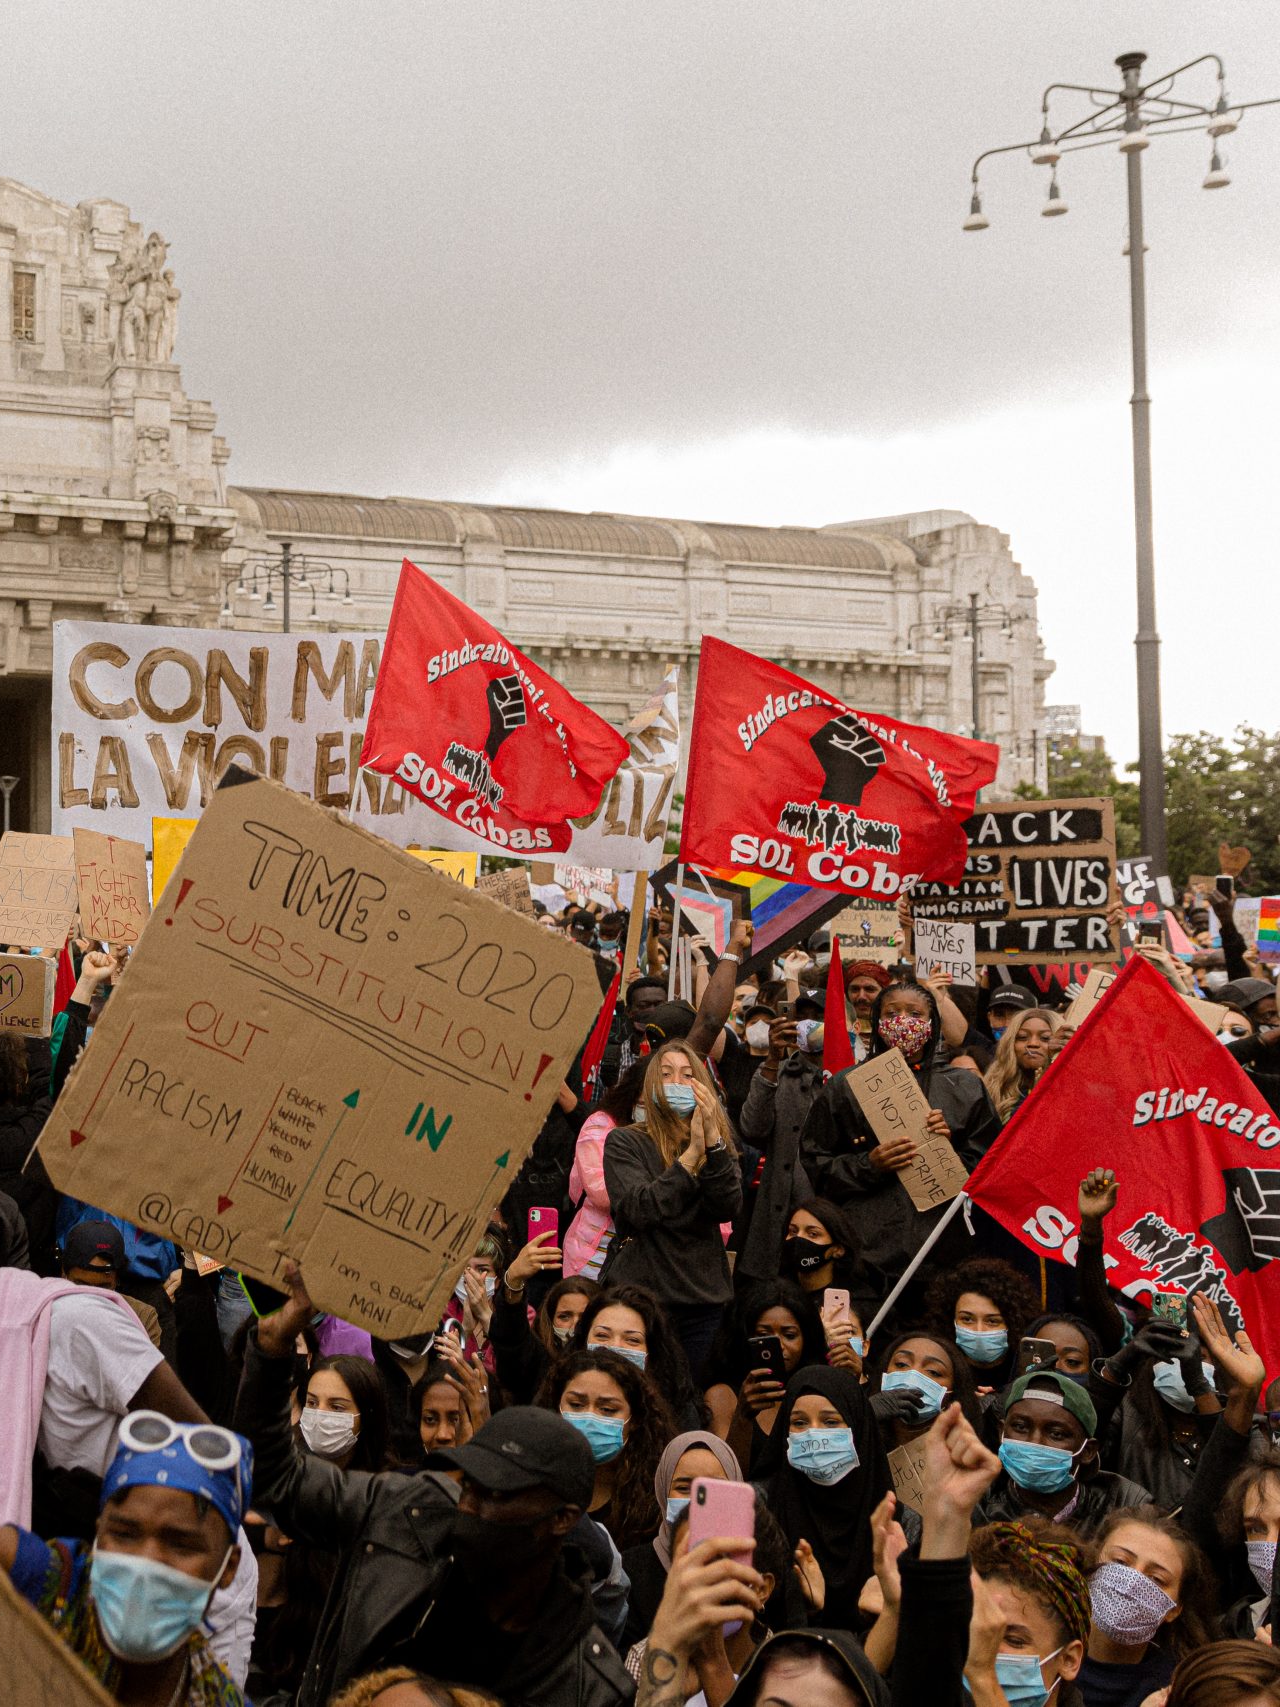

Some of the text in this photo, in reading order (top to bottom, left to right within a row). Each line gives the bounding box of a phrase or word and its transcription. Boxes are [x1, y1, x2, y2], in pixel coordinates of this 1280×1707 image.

[69, 640, 268, 733] CON
[57, 731, 141, 810] LA
[395, 752, 553, 850] SOL Cobas
[0, 834, 76, 865] FUC
[730, 833, 796, 876] SOL
[807, 851, 925, 897] Coba
[112, 894, 142, 916] FOR
[1013, 859, 1109, 908] LIVES
[916, 920, 955, 939] BLACK
[930, 938, 966, 956] LIVES
[979, 916, 1110, 951] TTER
[414, 914, 575, 1032] 2020
[185, 998, 270, 1059] OUT
[120, 1058, 244, 1145] RACISM
[405, 1102, 453, 1152] IN
[884, 1056, 957, 1180] BEING BLACK
[1132, 1086, 1280, 1149] Sindacato
[865, 1073, 947, 1204] IS NOT CRIME
[244, 1160, 297, 1199] HUMAN
[349, 1292, 393, 1325] MAN!
[800, 1438, 830, 1454] STOP
